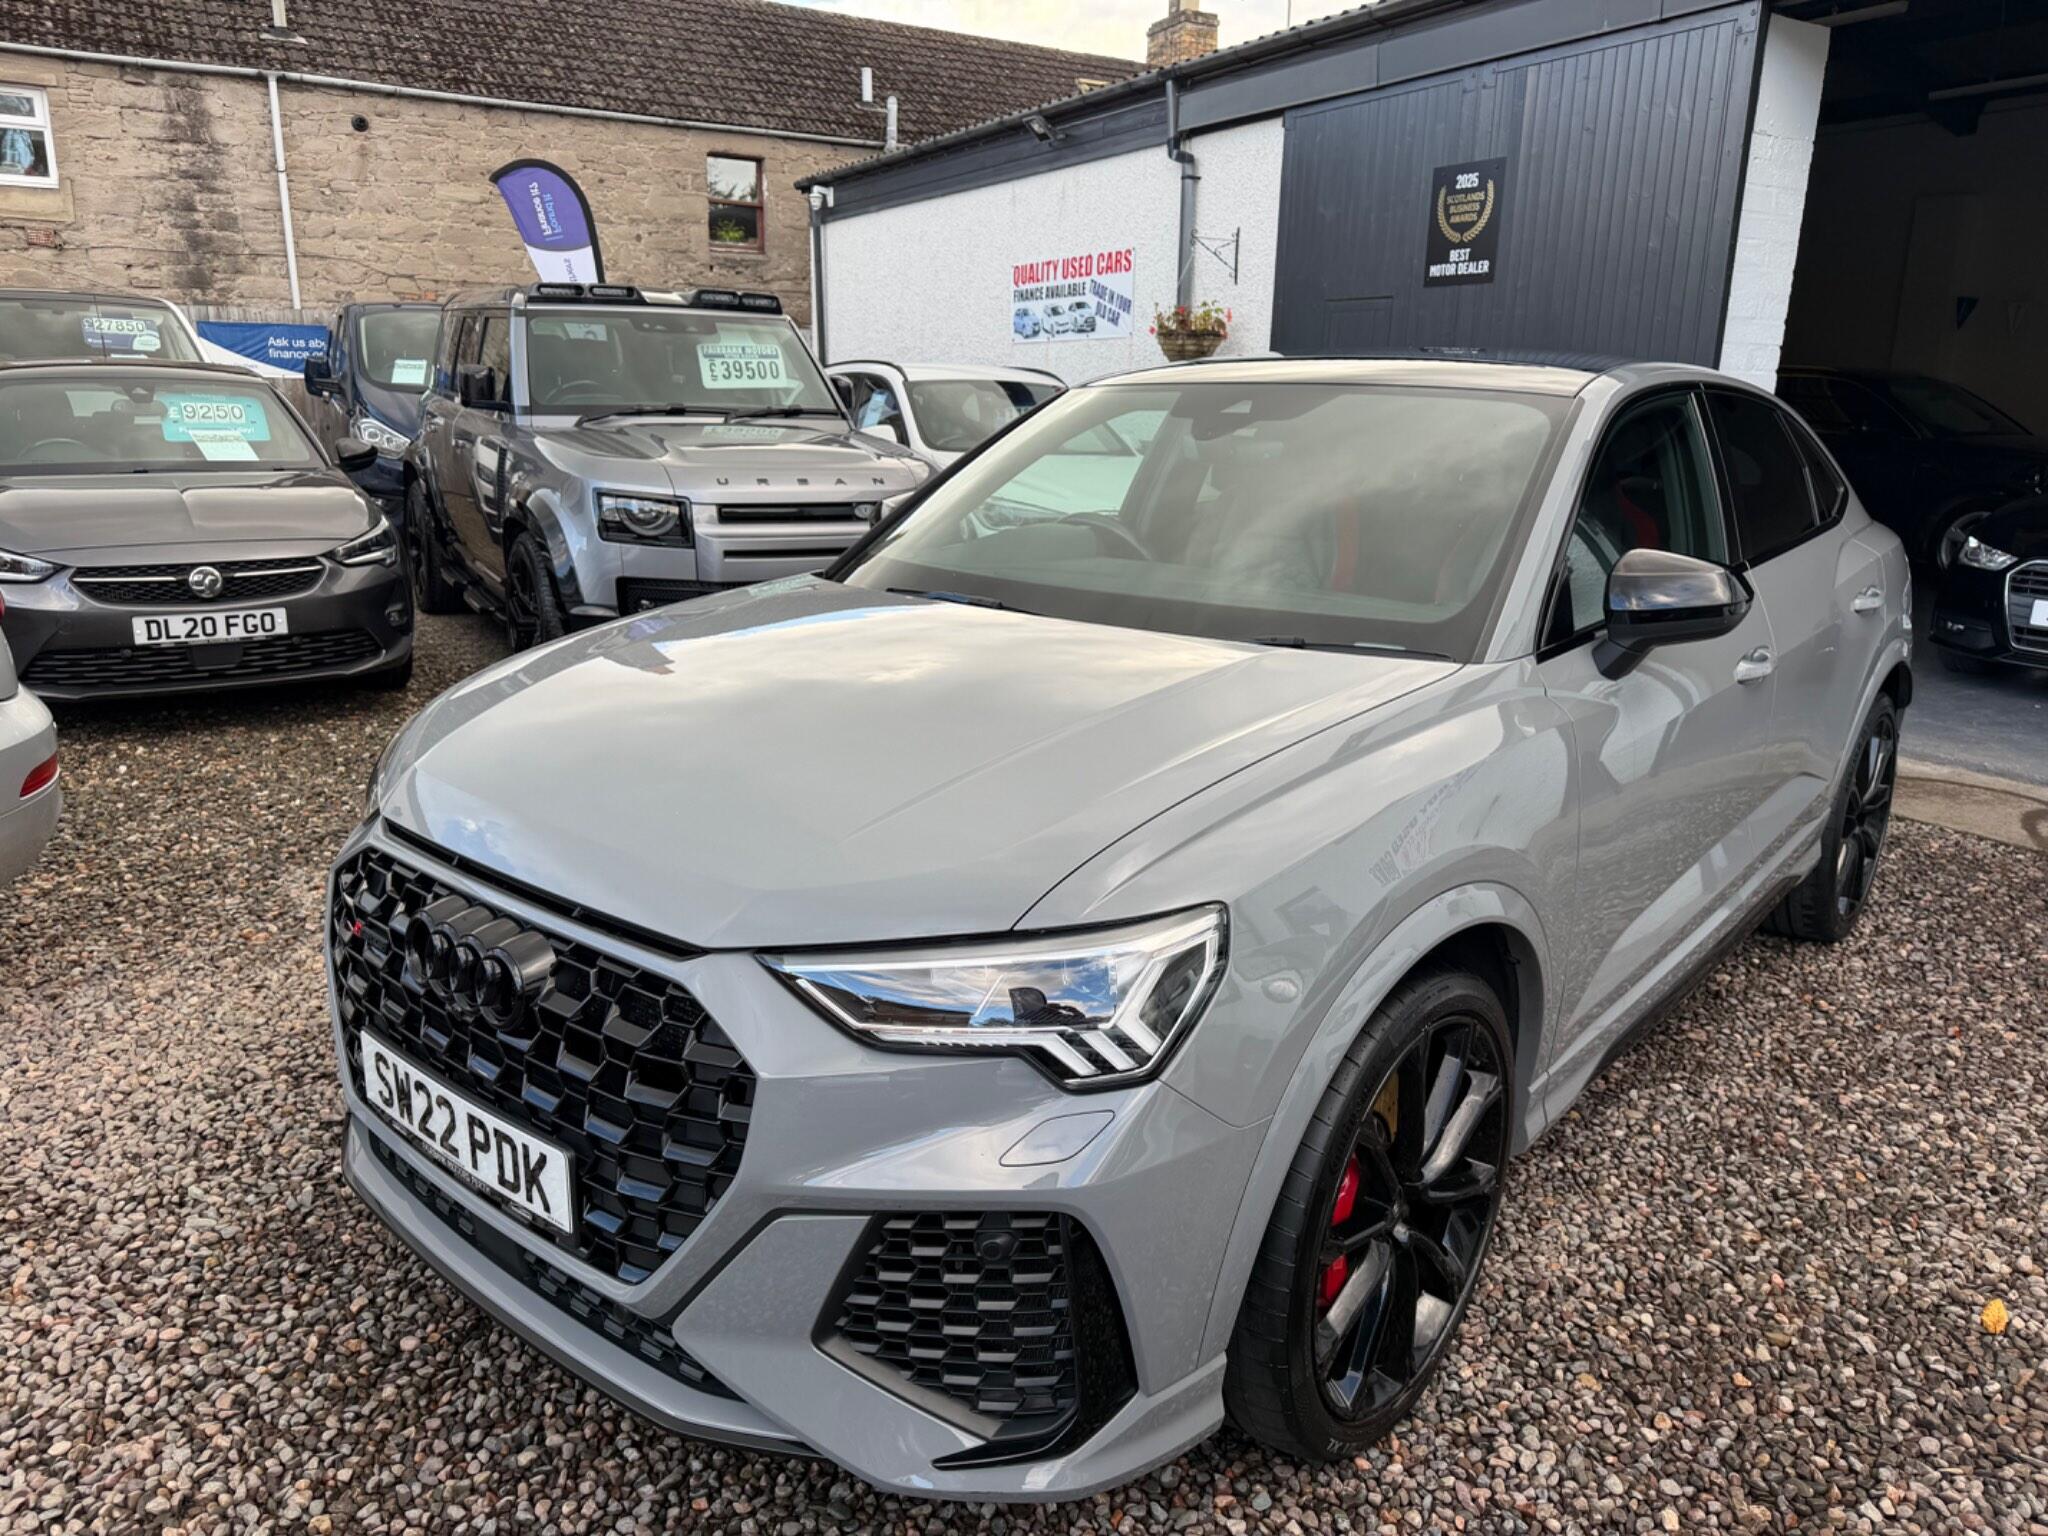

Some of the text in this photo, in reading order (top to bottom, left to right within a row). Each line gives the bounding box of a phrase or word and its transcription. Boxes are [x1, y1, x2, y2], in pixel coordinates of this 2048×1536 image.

[1456, 172, 1480, 190] 2025
[1446, 191, 1485, 205] SCOTLANDS
[1449, 202, 1480, 214] BUSINESS
[1449, 212, 1478, 224] AWARDS
[1449, 248, 1471, 262] BEST
[1013, 248, 1132, 288] QUALITY USED CARS
[1429, 260, 1490, 277] MOTOR DEALER
[1013, 282, 1086, 303] FINANCE AVAILABLE
[1090, 279, 1108, 301] TRADE
[267, 336, 288, 347] Ask
[292, 339, 306, 348] us
[269, 348, 308, 359] finance
[708, 359, 780, 382] £39500
[168, 403, 244, 420] £9250
[716, 478, 886, 487] URBAN
[144, 616, 218, 641] DL20
[224, 612, 276, 636] FGO
[374, 1051, 551, 1214] SW22 PDK
